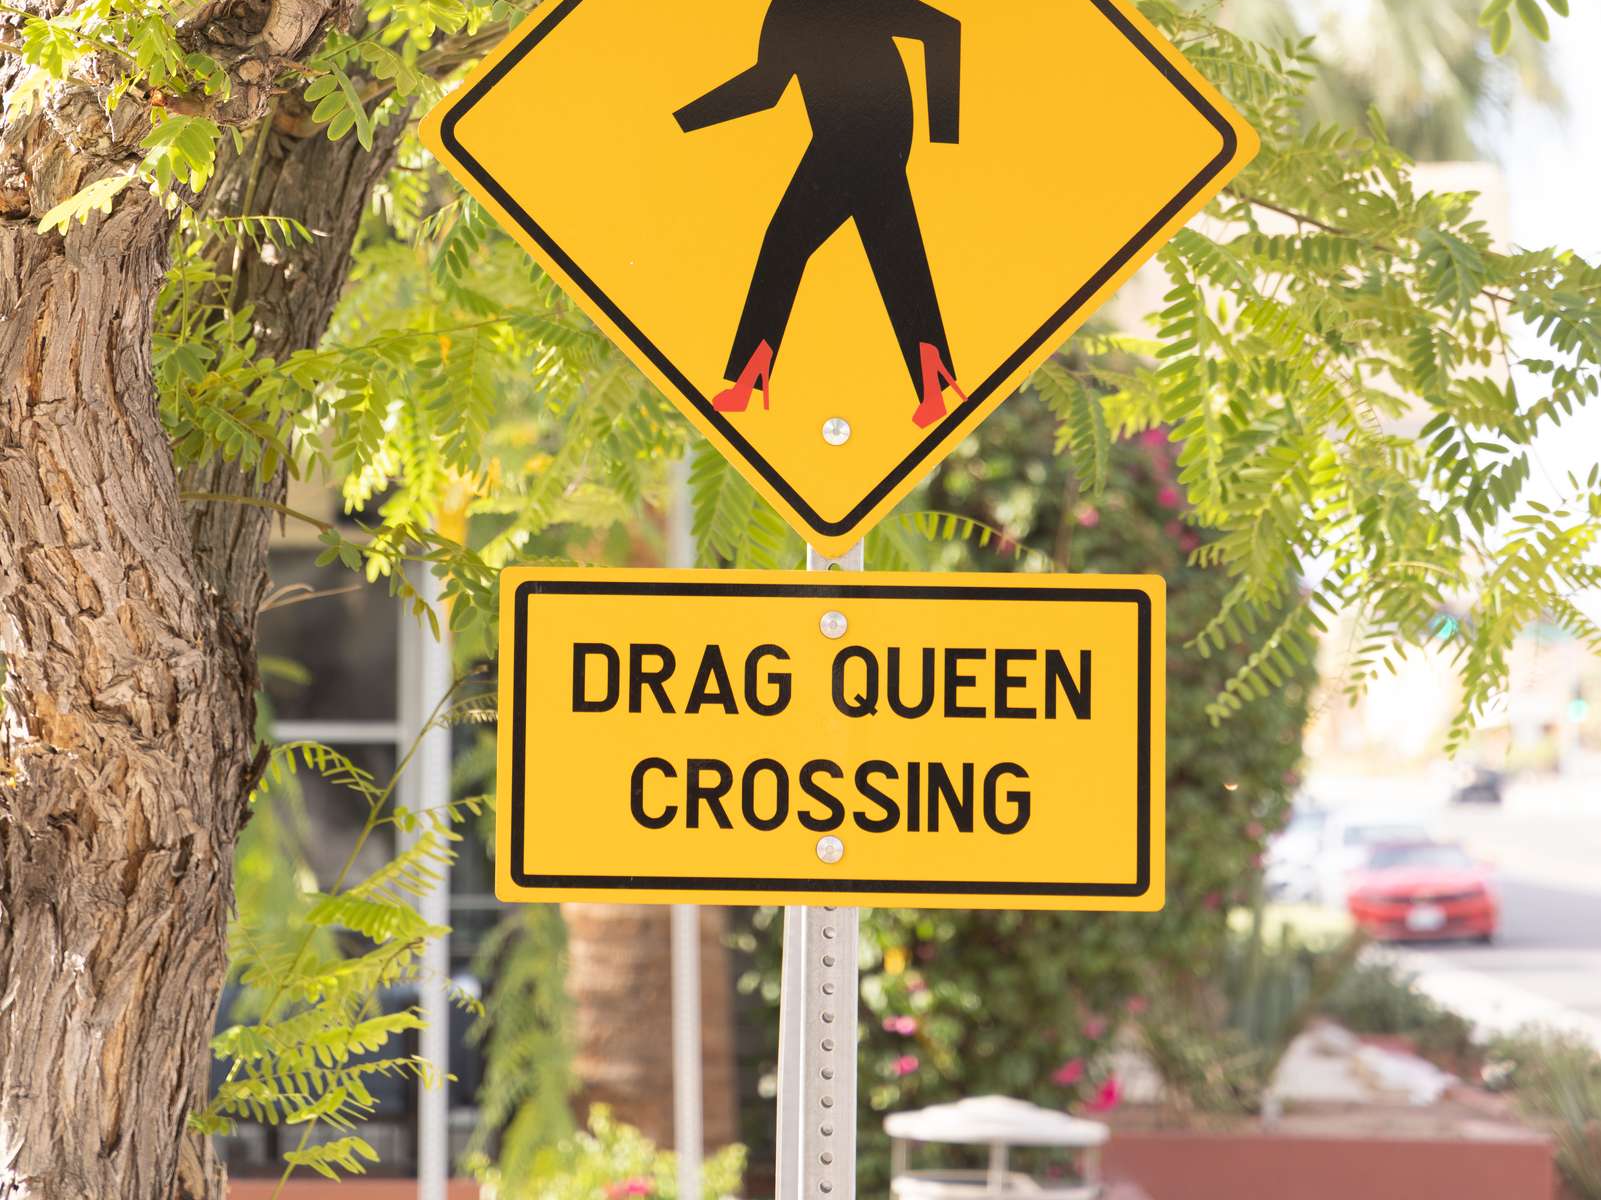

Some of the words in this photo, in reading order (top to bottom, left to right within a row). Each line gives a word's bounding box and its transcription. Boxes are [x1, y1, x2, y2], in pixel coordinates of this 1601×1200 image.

[572, 642, 792, 717] DRAG
[831, 645, 1092, 720] QUEEN
[630, 756, 1031, 835] CROSSING
